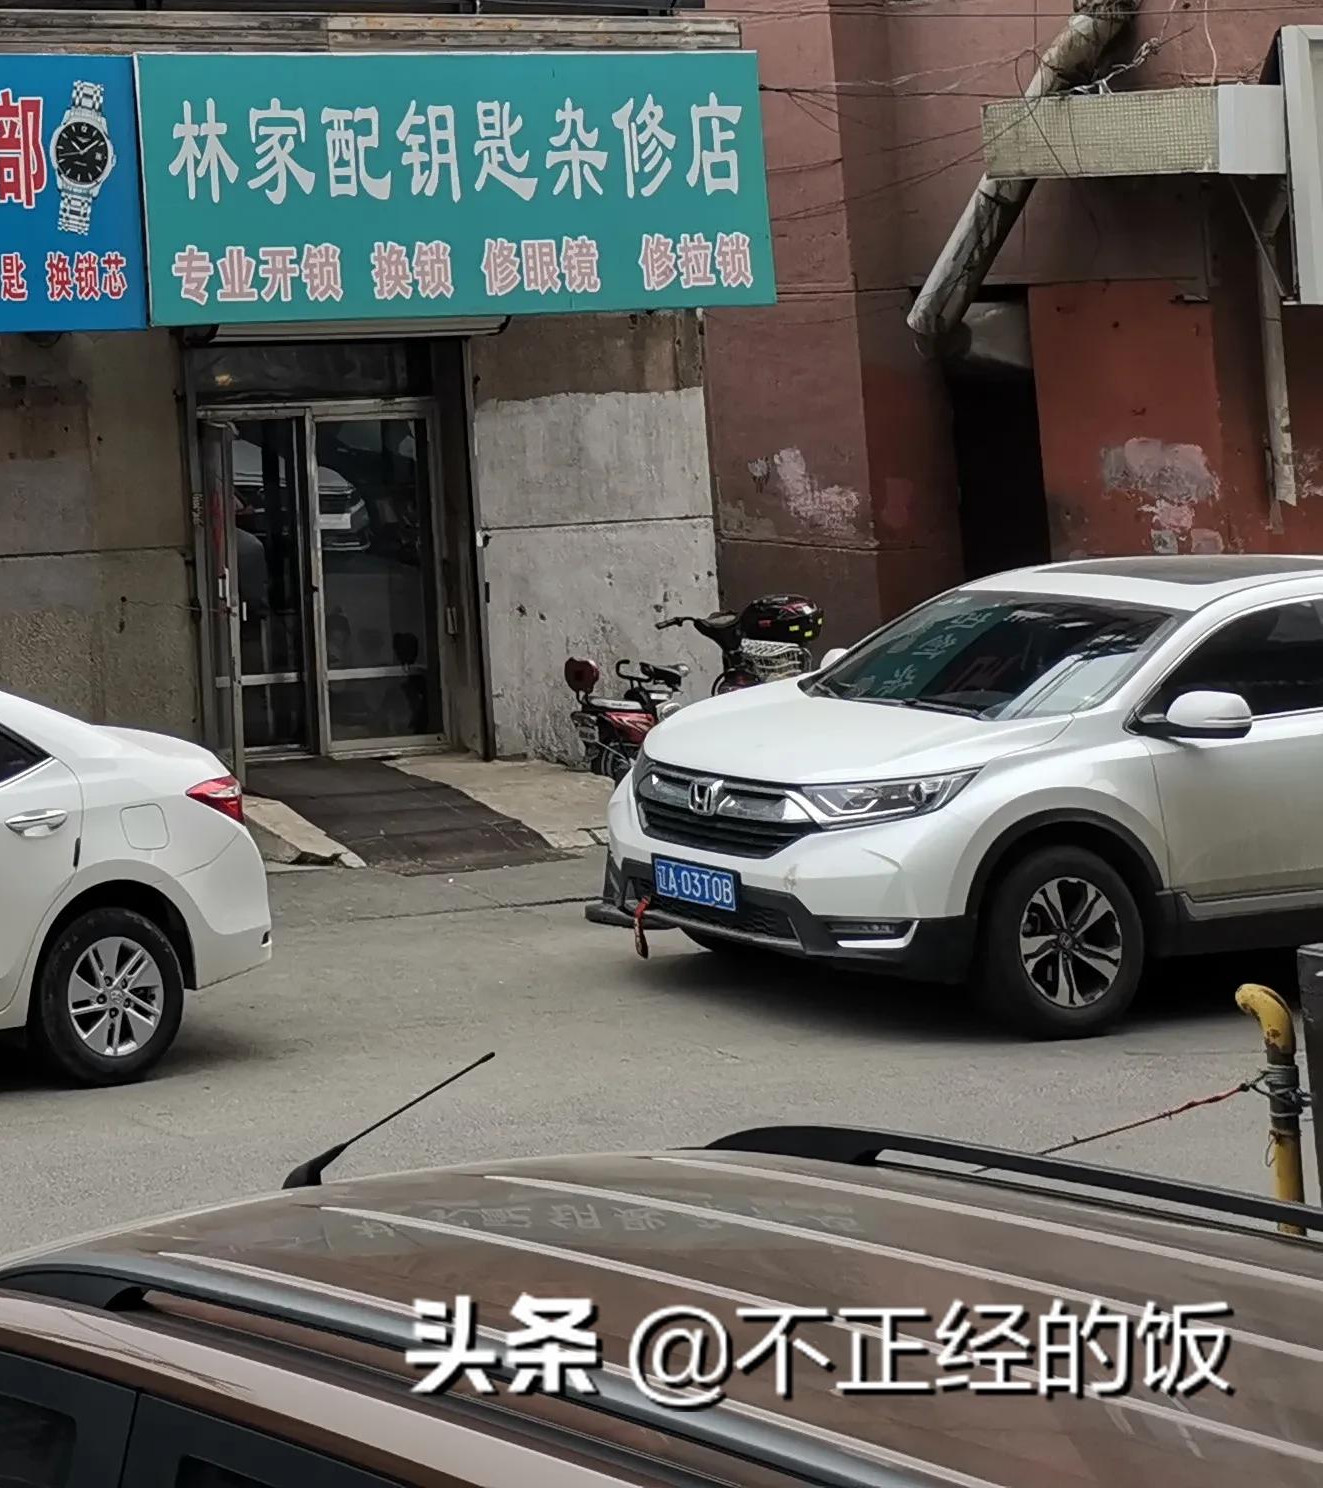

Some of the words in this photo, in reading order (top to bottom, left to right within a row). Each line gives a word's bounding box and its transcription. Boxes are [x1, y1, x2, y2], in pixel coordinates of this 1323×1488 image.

[168, 91, 743, 204] 林家配钥匙杂修店
[46, 251, 128, 301] 换锁芯
[171, 243, 344, 305] 专业开锁
[370, 240, 455, 301] 换锁
[480, 235, 602, 297] 修眼镜
[638, 230, 754, 292] 修拉锁
